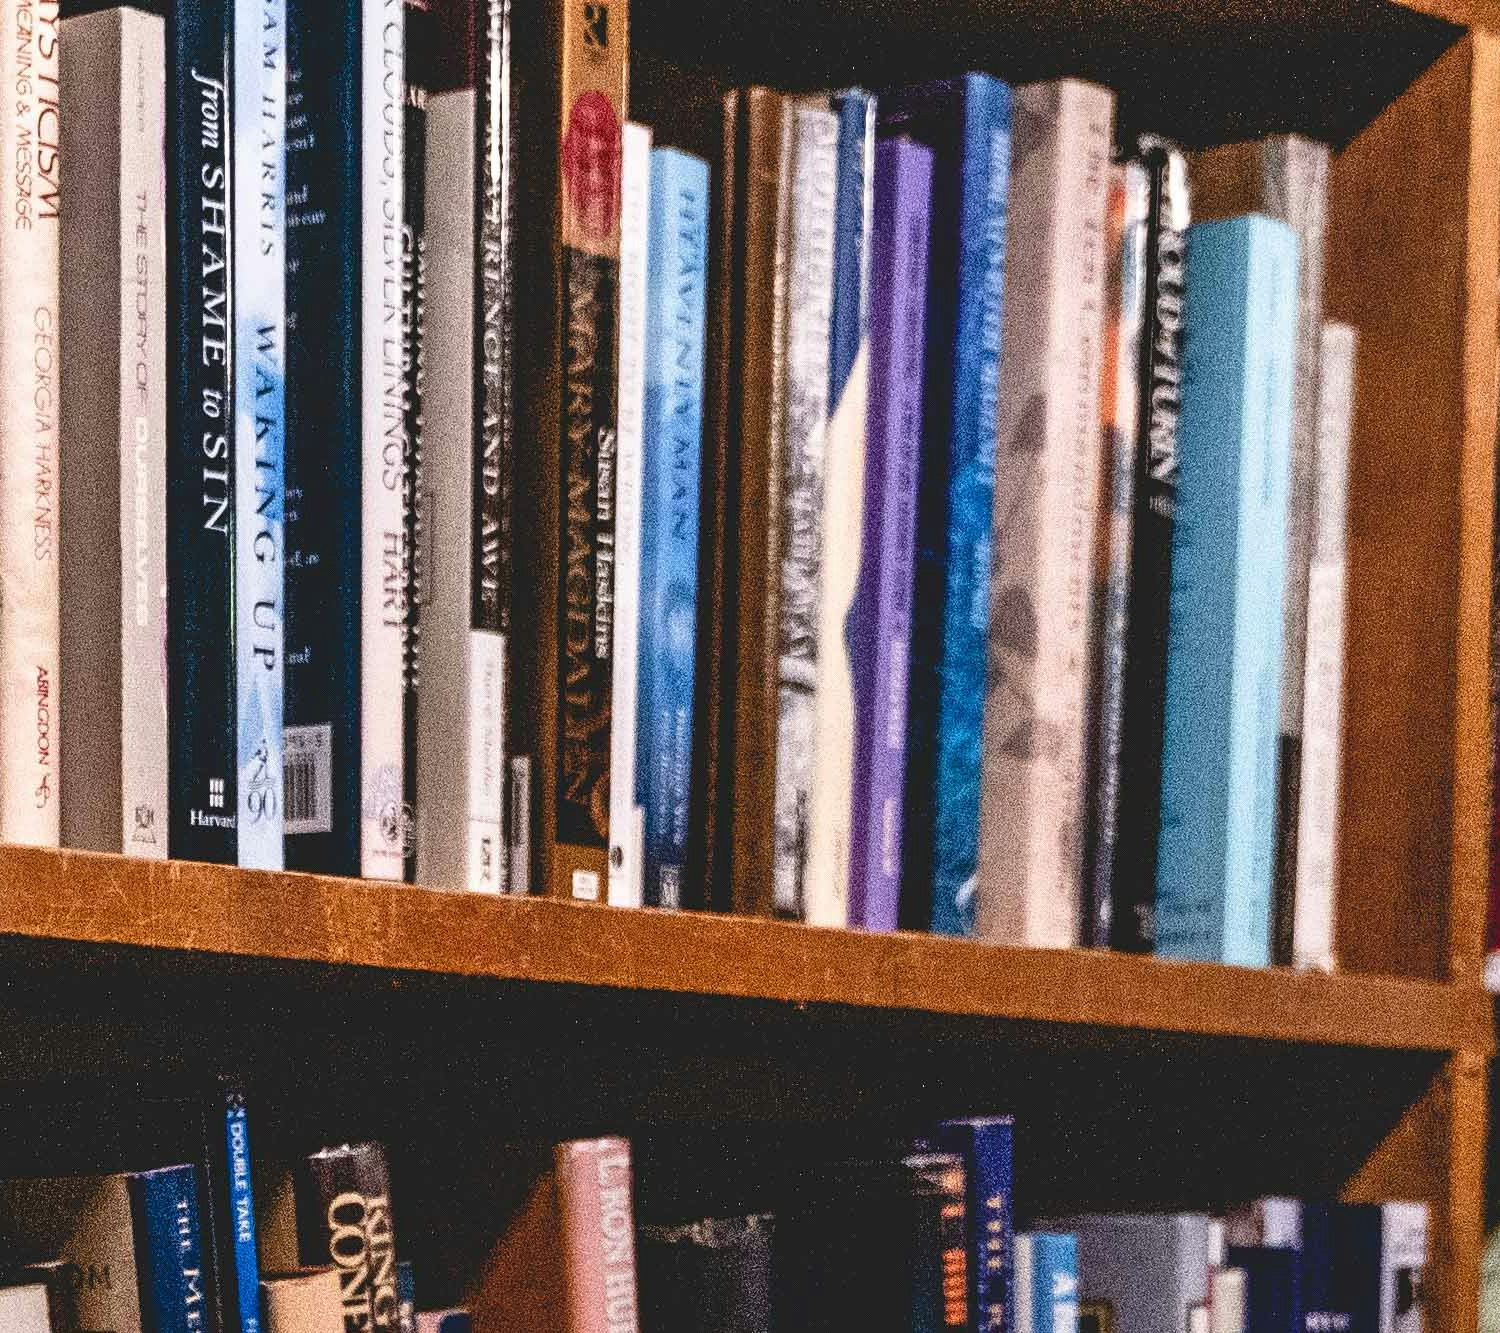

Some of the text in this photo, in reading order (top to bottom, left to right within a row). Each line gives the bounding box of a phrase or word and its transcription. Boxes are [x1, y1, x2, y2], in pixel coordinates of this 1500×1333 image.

[192, 70, 229, 536] from SHAME to SIN
[598, 1190, 637, 1268] RON
